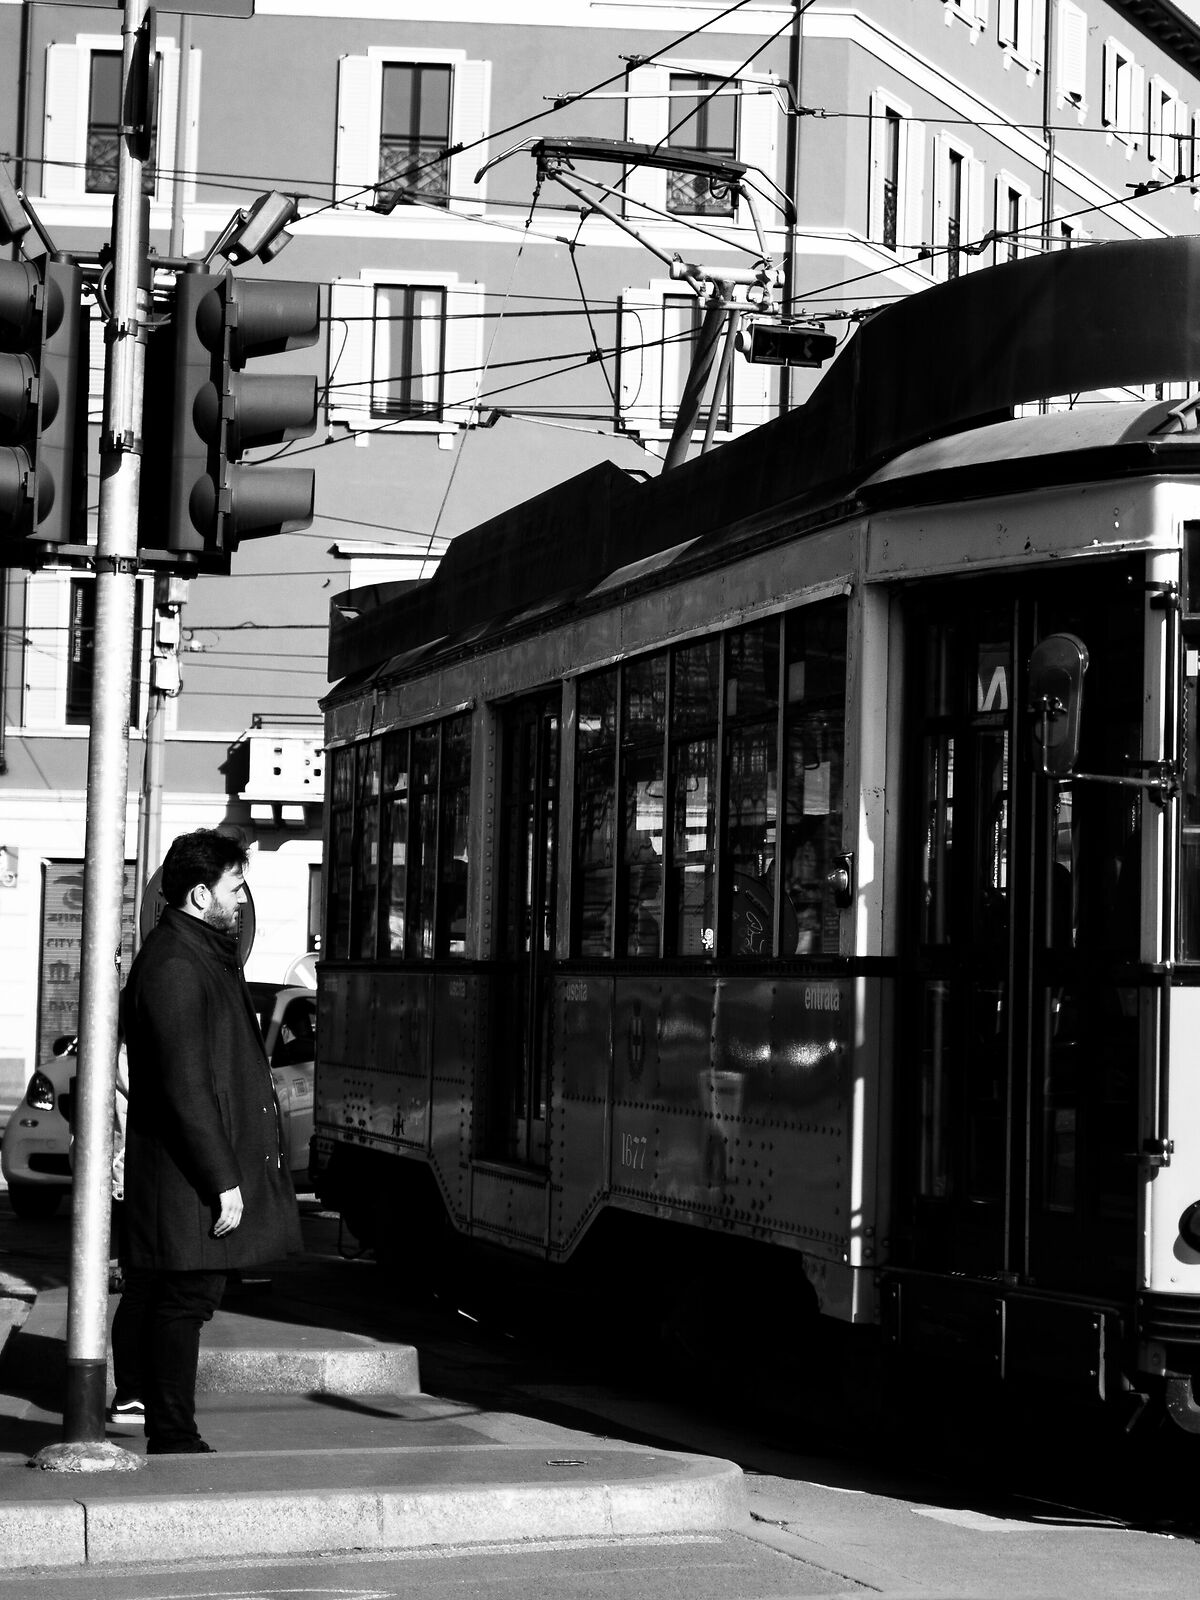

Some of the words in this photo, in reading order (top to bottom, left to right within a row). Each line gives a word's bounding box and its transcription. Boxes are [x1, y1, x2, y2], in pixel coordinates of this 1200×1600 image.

[566, 979, 588, 1001] uscita
[804, 984, 840, 1011] entrata
[622, 1132, 647, 1169] 1677
